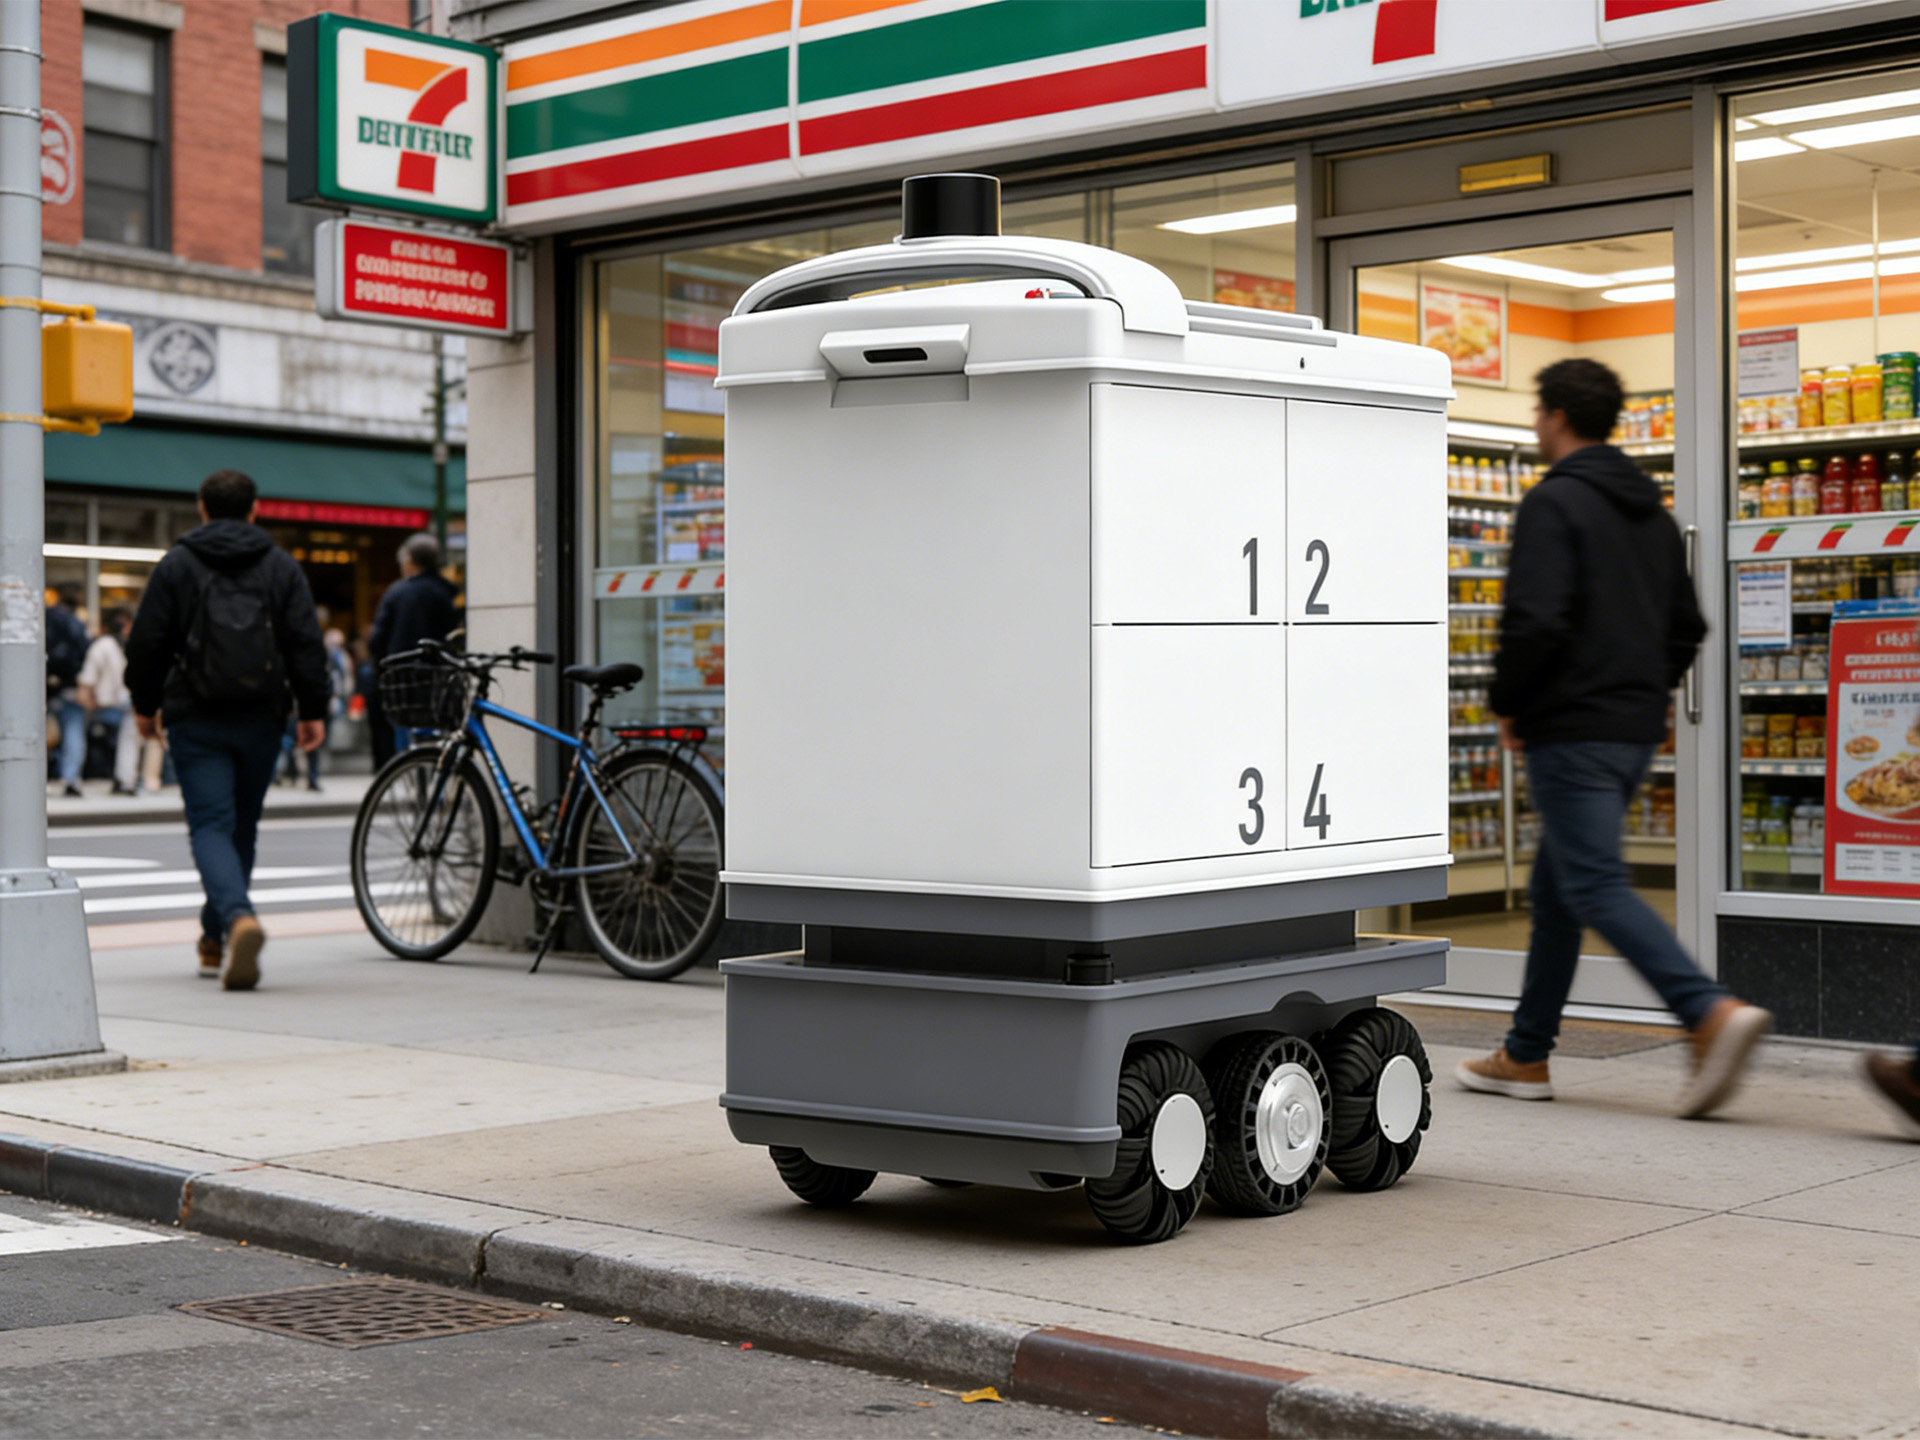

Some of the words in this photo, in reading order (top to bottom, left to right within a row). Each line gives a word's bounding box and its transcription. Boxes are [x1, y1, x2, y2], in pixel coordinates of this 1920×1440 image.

[1243, 537, 1258, 616] 1
[1305, 539, 1330, 615] 2
[1238, 767, 1265, 846] 3
[1303, 762, 1331, 840] 4
